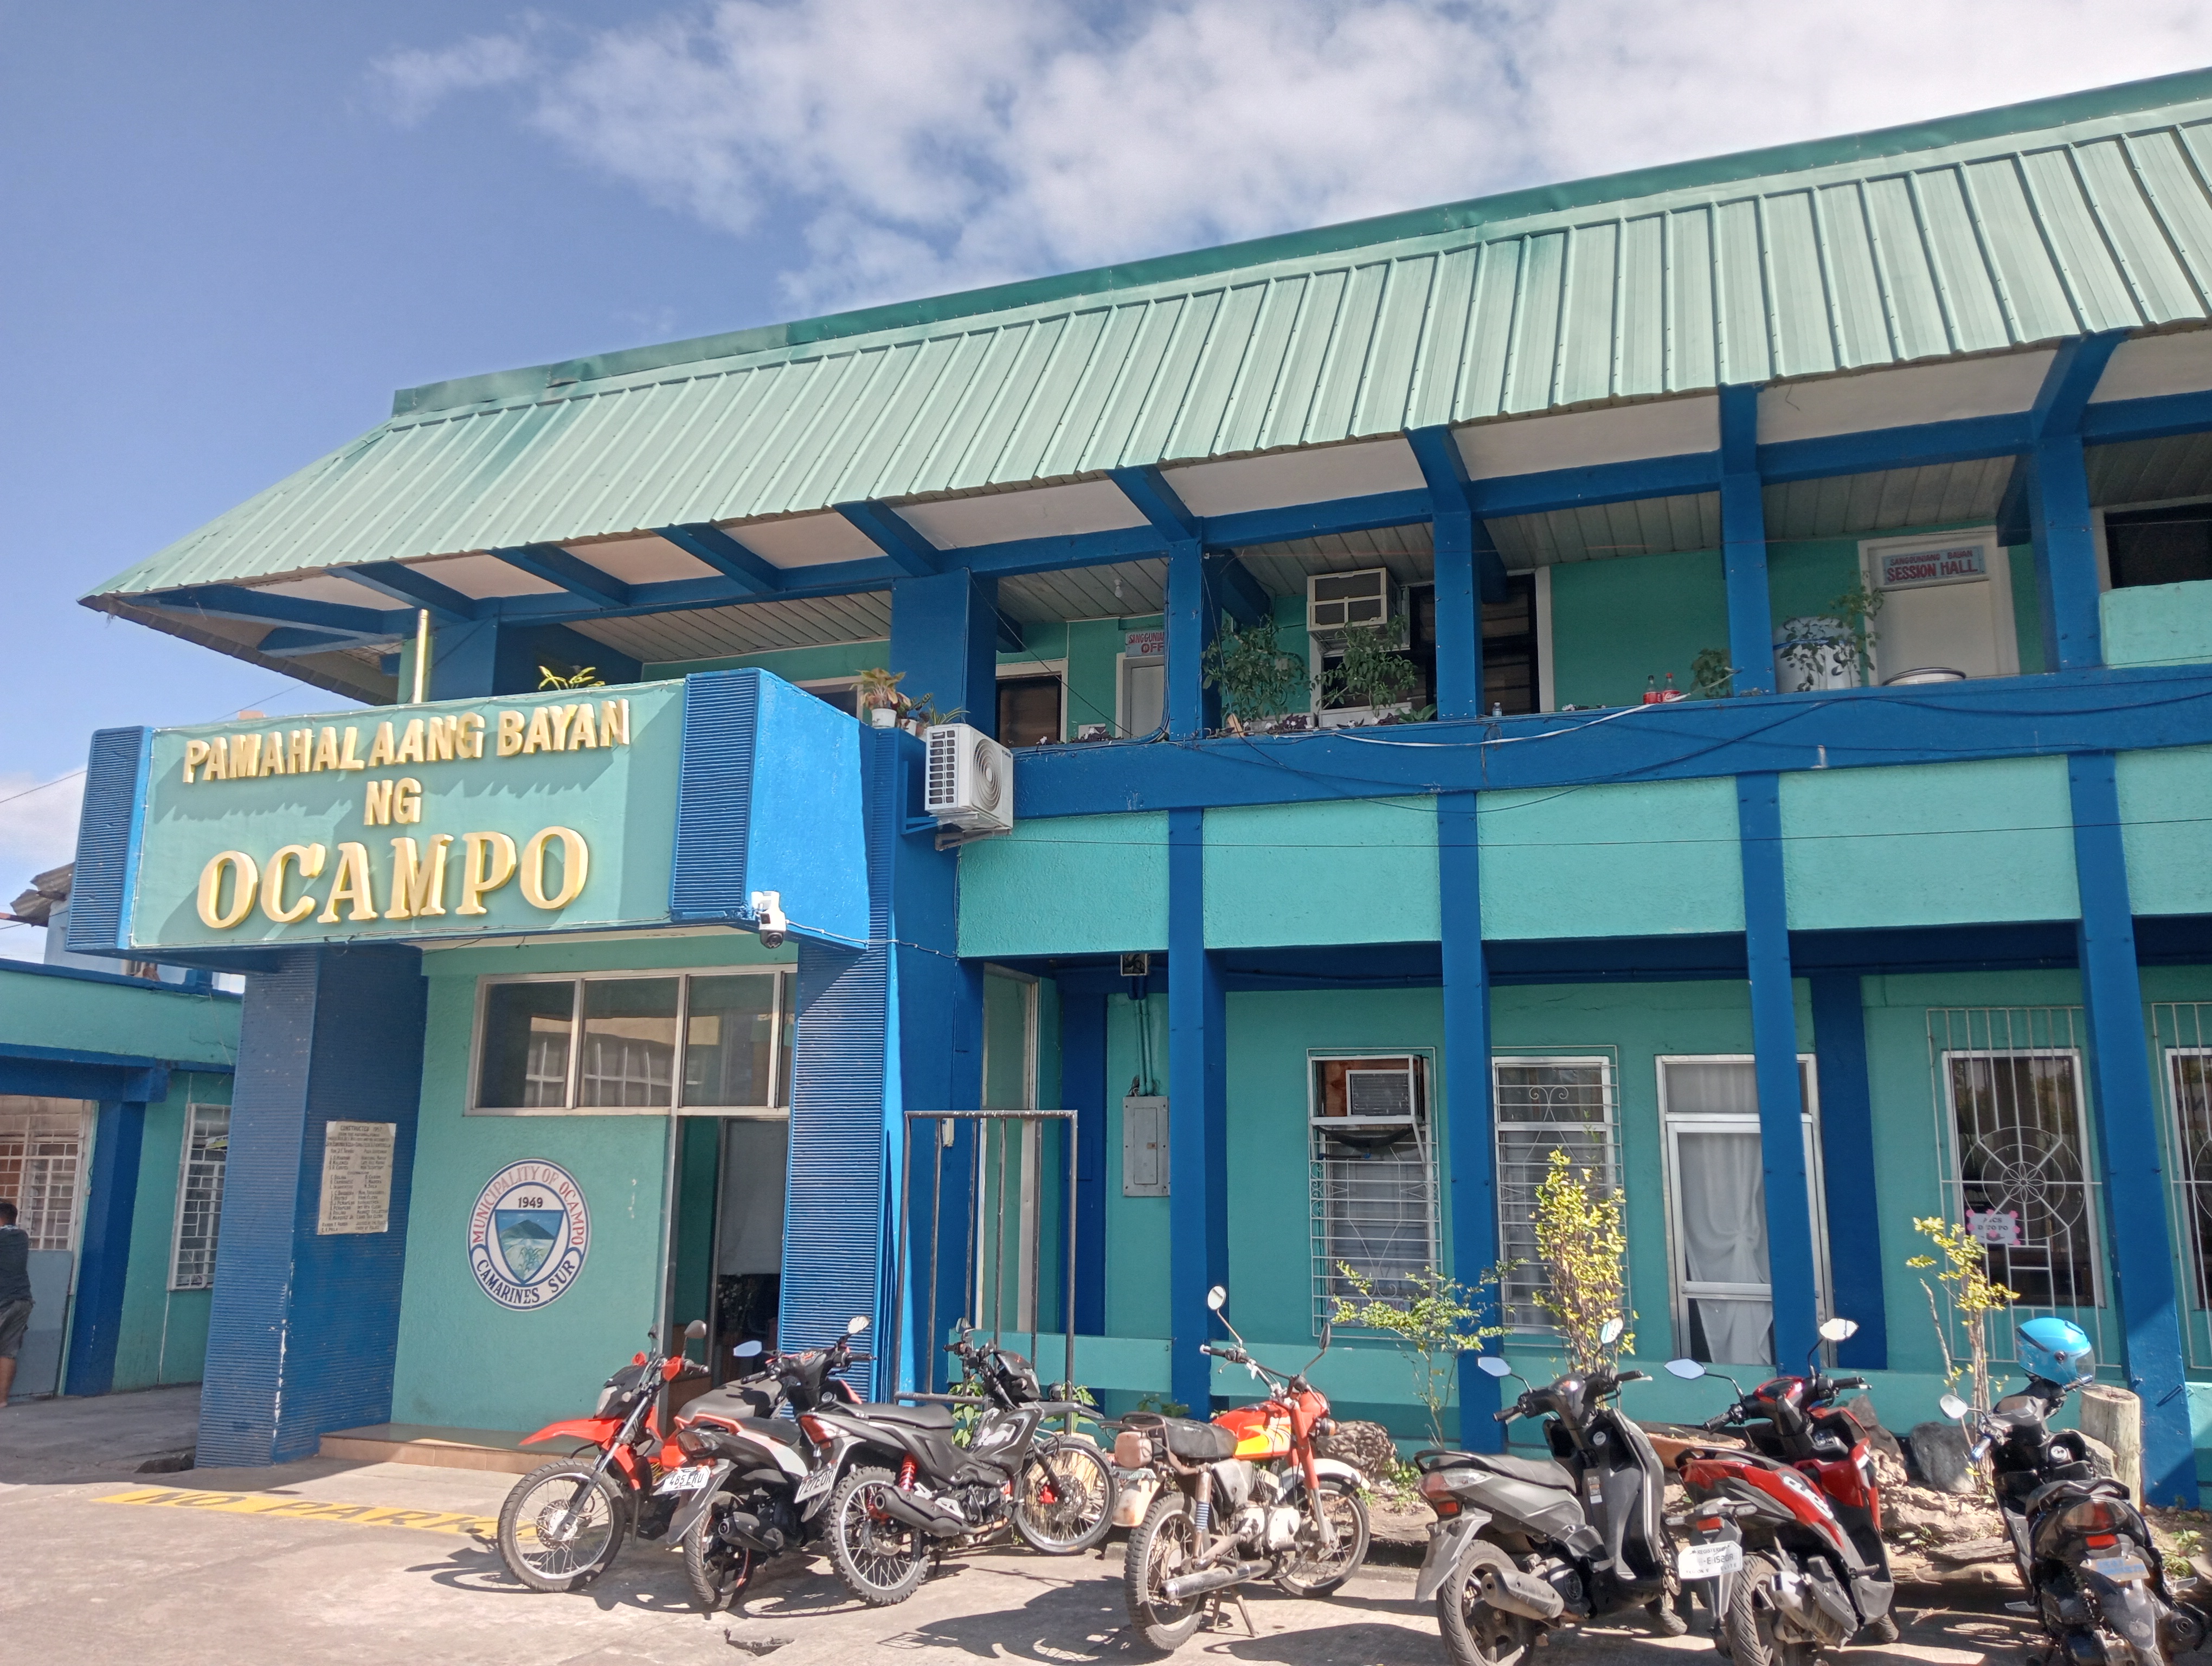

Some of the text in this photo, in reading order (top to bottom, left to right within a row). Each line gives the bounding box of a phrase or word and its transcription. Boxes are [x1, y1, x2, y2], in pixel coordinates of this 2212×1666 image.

[1887, 559, 1978, 582] SESSION HALL
[1129, 632, 1165, 644] SANGGUNIA
[183, 698, 630, 784] PAMAHALAANG BAYAN
[363, 777, 421, 825] NG
[196, 826, 589, 930] OCAMPO
[472, 1165, 584, 1245] MUNICIPALITY OF OCAMPO
[518, 1197, 543, 1208] 1949
[477, 1259, 575, 1304] CAMARINES SUR
[124, 1491, 537, 1534] NO PARK
